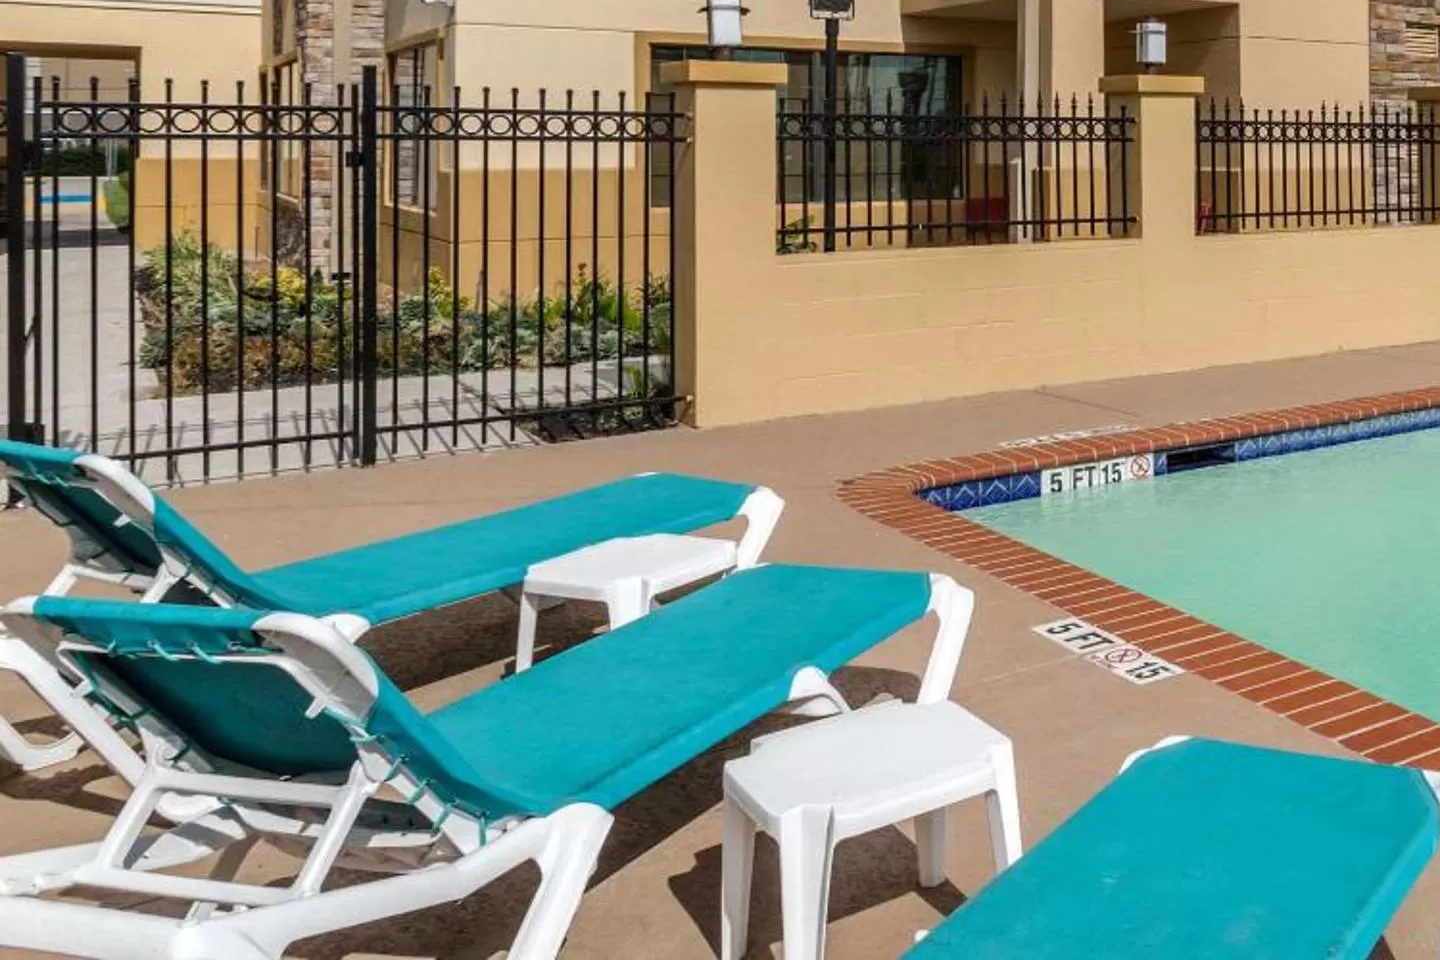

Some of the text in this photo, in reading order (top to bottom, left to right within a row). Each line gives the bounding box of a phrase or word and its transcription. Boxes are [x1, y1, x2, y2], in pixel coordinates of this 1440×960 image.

[1050, 471, 1063, 493] 5
[1072, 465, 1097, 490] FT
[1045, 621, 1084, 635] 5
[1063, 631, 1116, 650] FT
